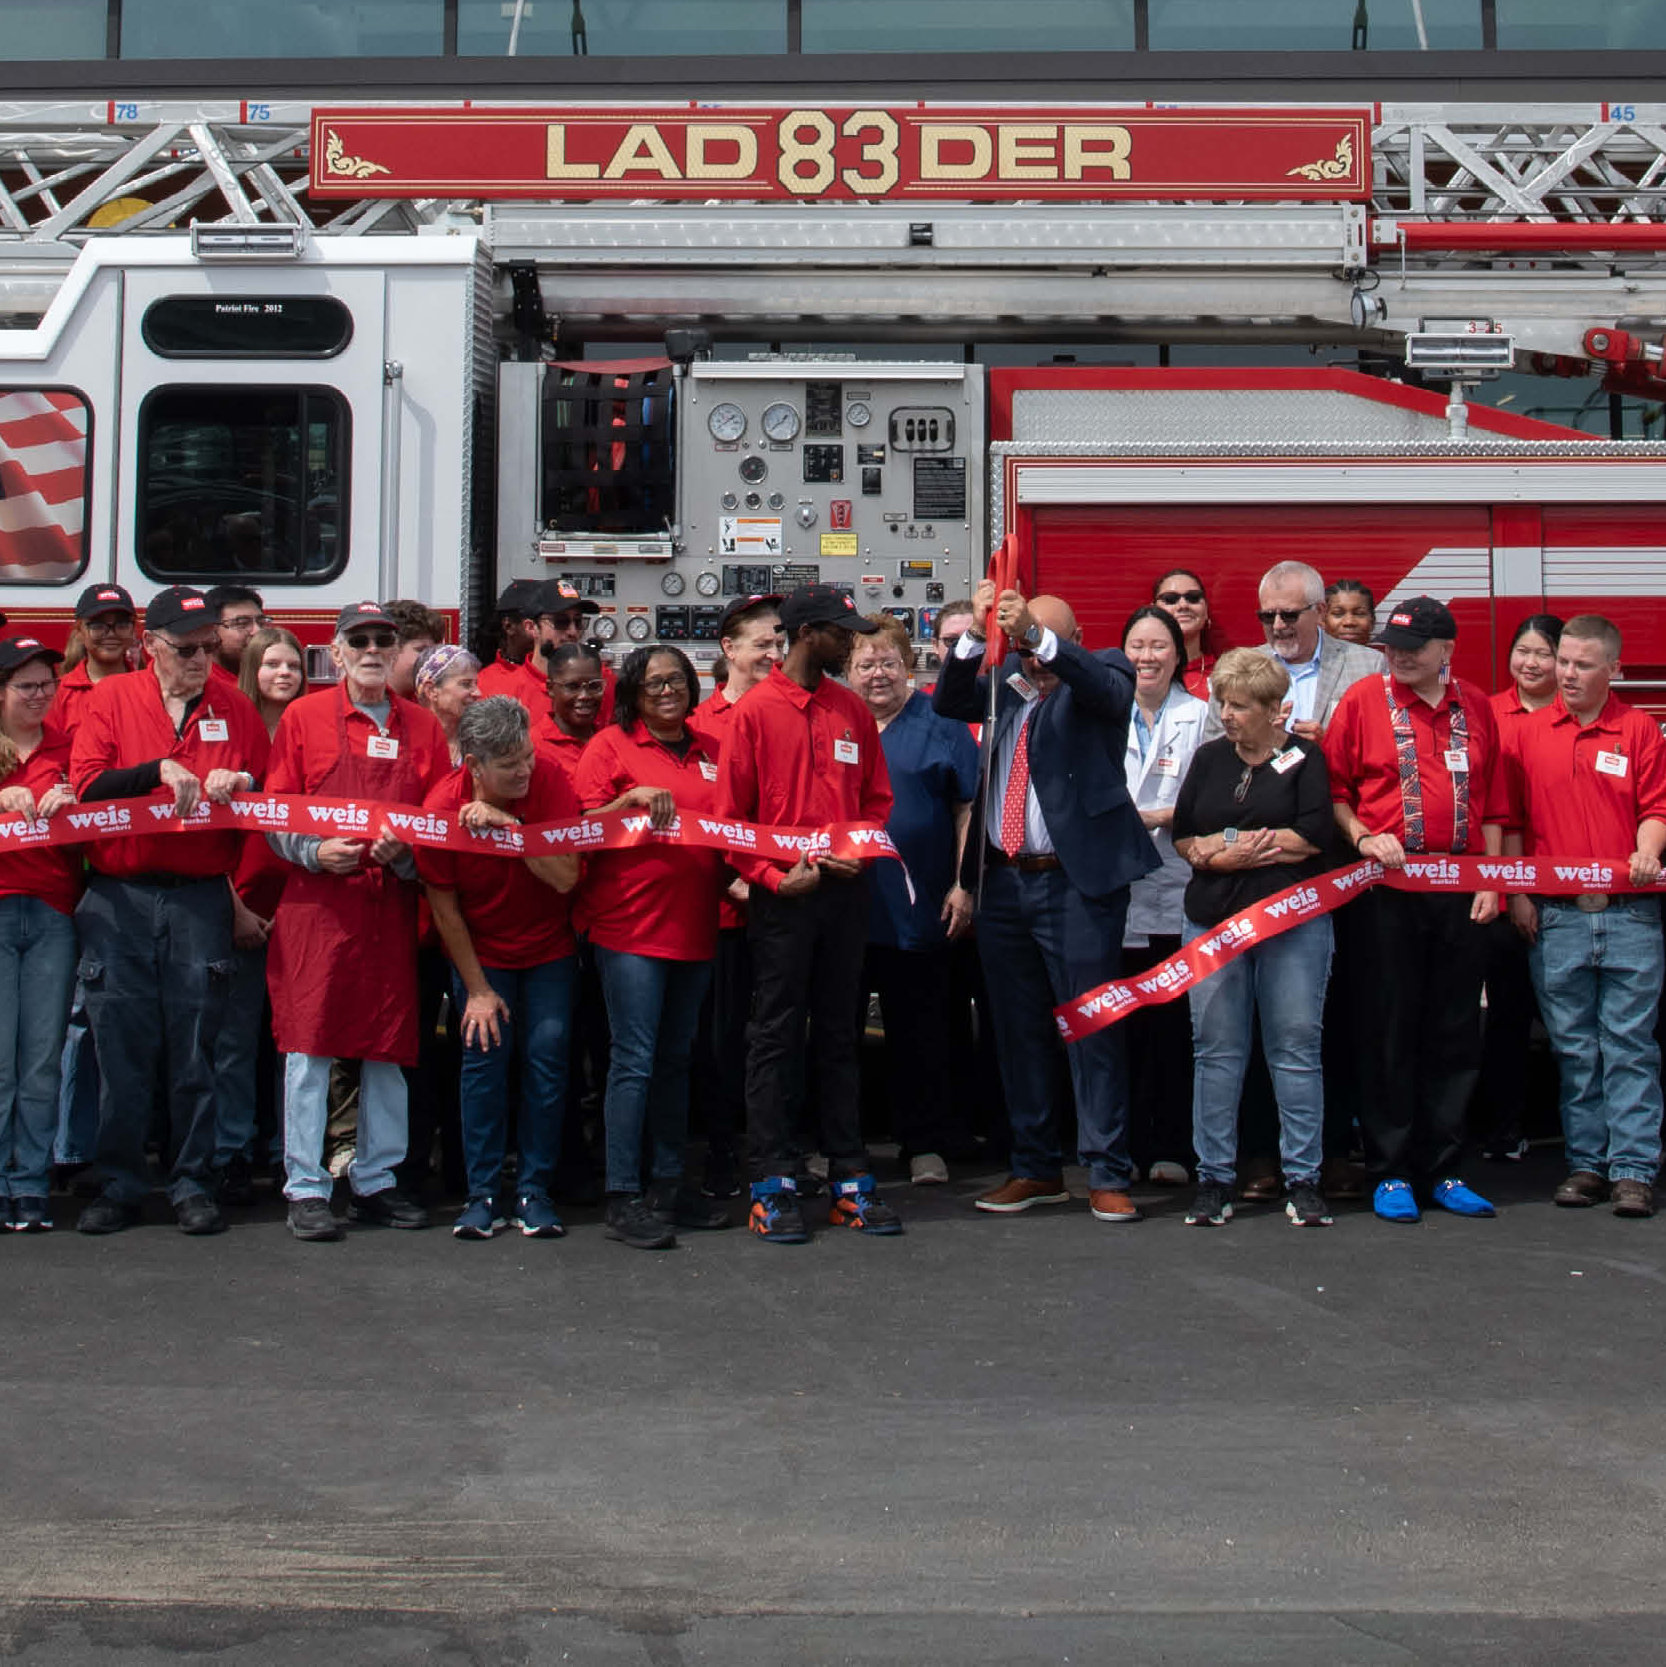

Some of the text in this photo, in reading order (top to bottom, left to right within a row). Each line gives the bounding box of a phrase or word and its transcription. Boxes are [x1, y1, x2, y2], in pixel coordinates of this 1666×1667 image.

[115, 103, 138, 121] 78
[248, 104, 270, 121] 75
[1610, 106, 1635, 121] 45
[545, 109, 1132, 195] LAD 83 DER
[264, 304, 283, 313] 2012
[67, 804, 131, 829] weis
[149, 800, 210, 820] ws
[230, 798, 289, 821] weis
[307, 803, 369, 824] weis
[387, 812, 448, 836] weis
[541, 819, 604, 843] weis
[698, 819, 756, 842] weis
[773, 831, 831, 851] weis
[847, 829, 890, 847] we
[1332, 861, 1384, 891] weis
[1403, 859, 1460, 879] weis
[1477, 861, 1536, 880] weis
[1554, 862, 1613, 882] weis
[1264, 887, 1318, 918] weis
[1198, 917, 1254, 957] weis
[1137, 960, 1190, 994] weis
[1078, 984, 1132, 1019] weis
